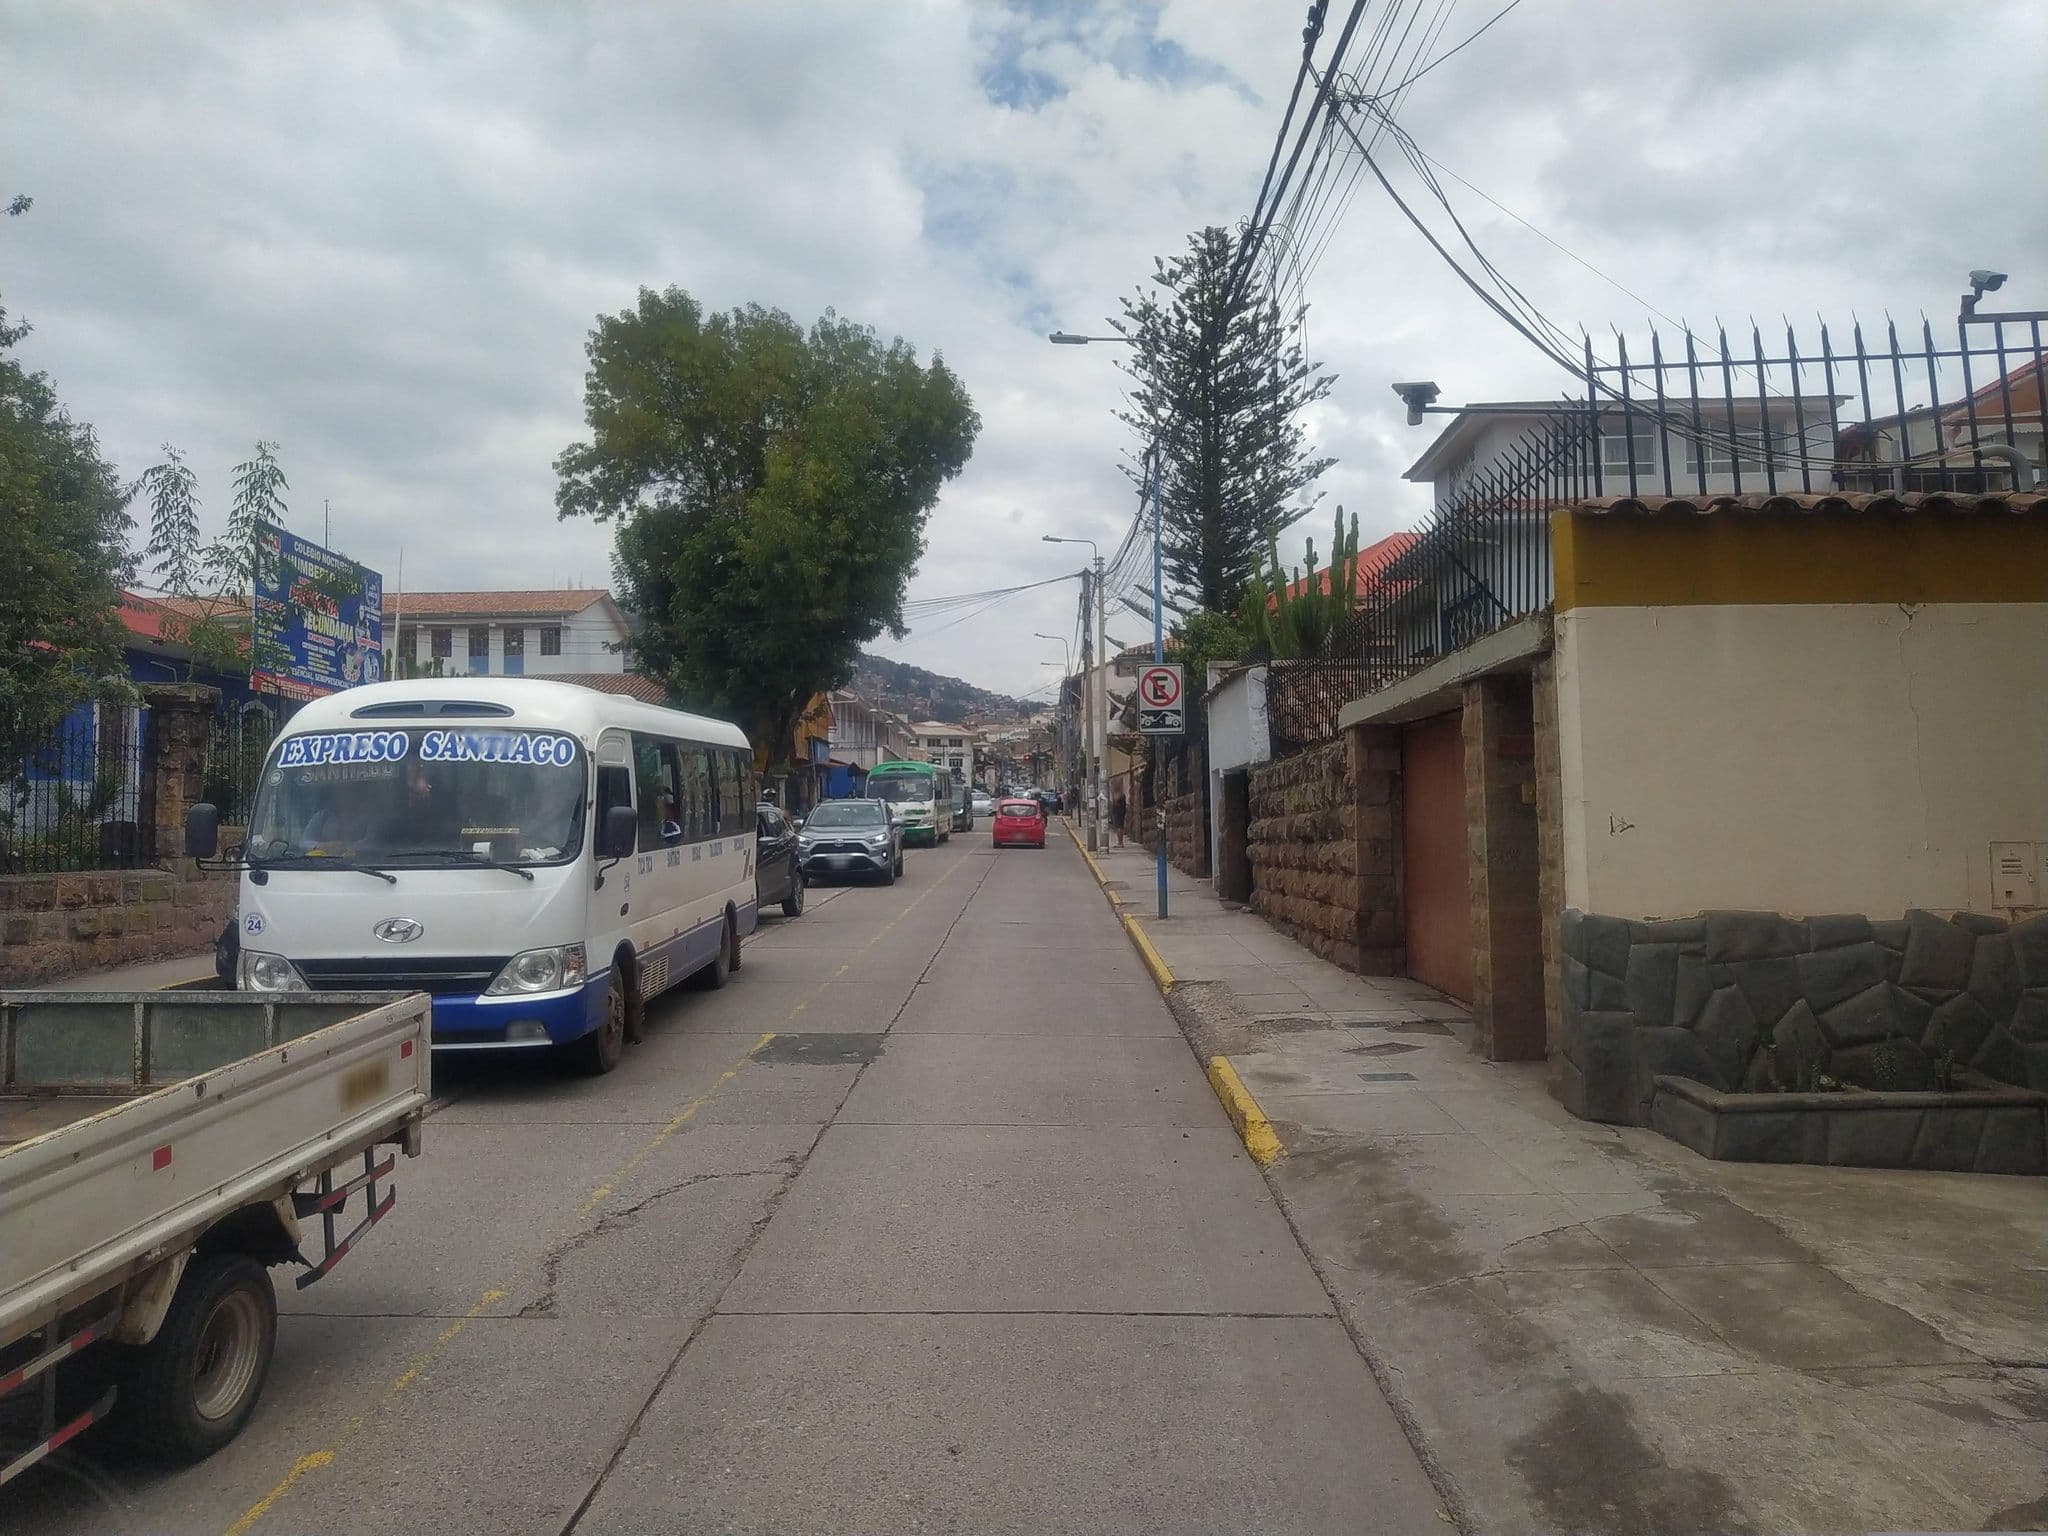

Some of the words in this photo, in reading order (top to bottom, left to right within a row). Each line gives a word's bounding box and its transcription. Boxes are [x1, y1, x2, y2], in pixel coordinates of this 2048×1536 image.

[293, 541, 321, 561] COLEGIO
[278, 731, 409, 768] EXPRESO
[420, 731, 576, 767] SANTIAGO
[247, 919, 262, 931] 24
